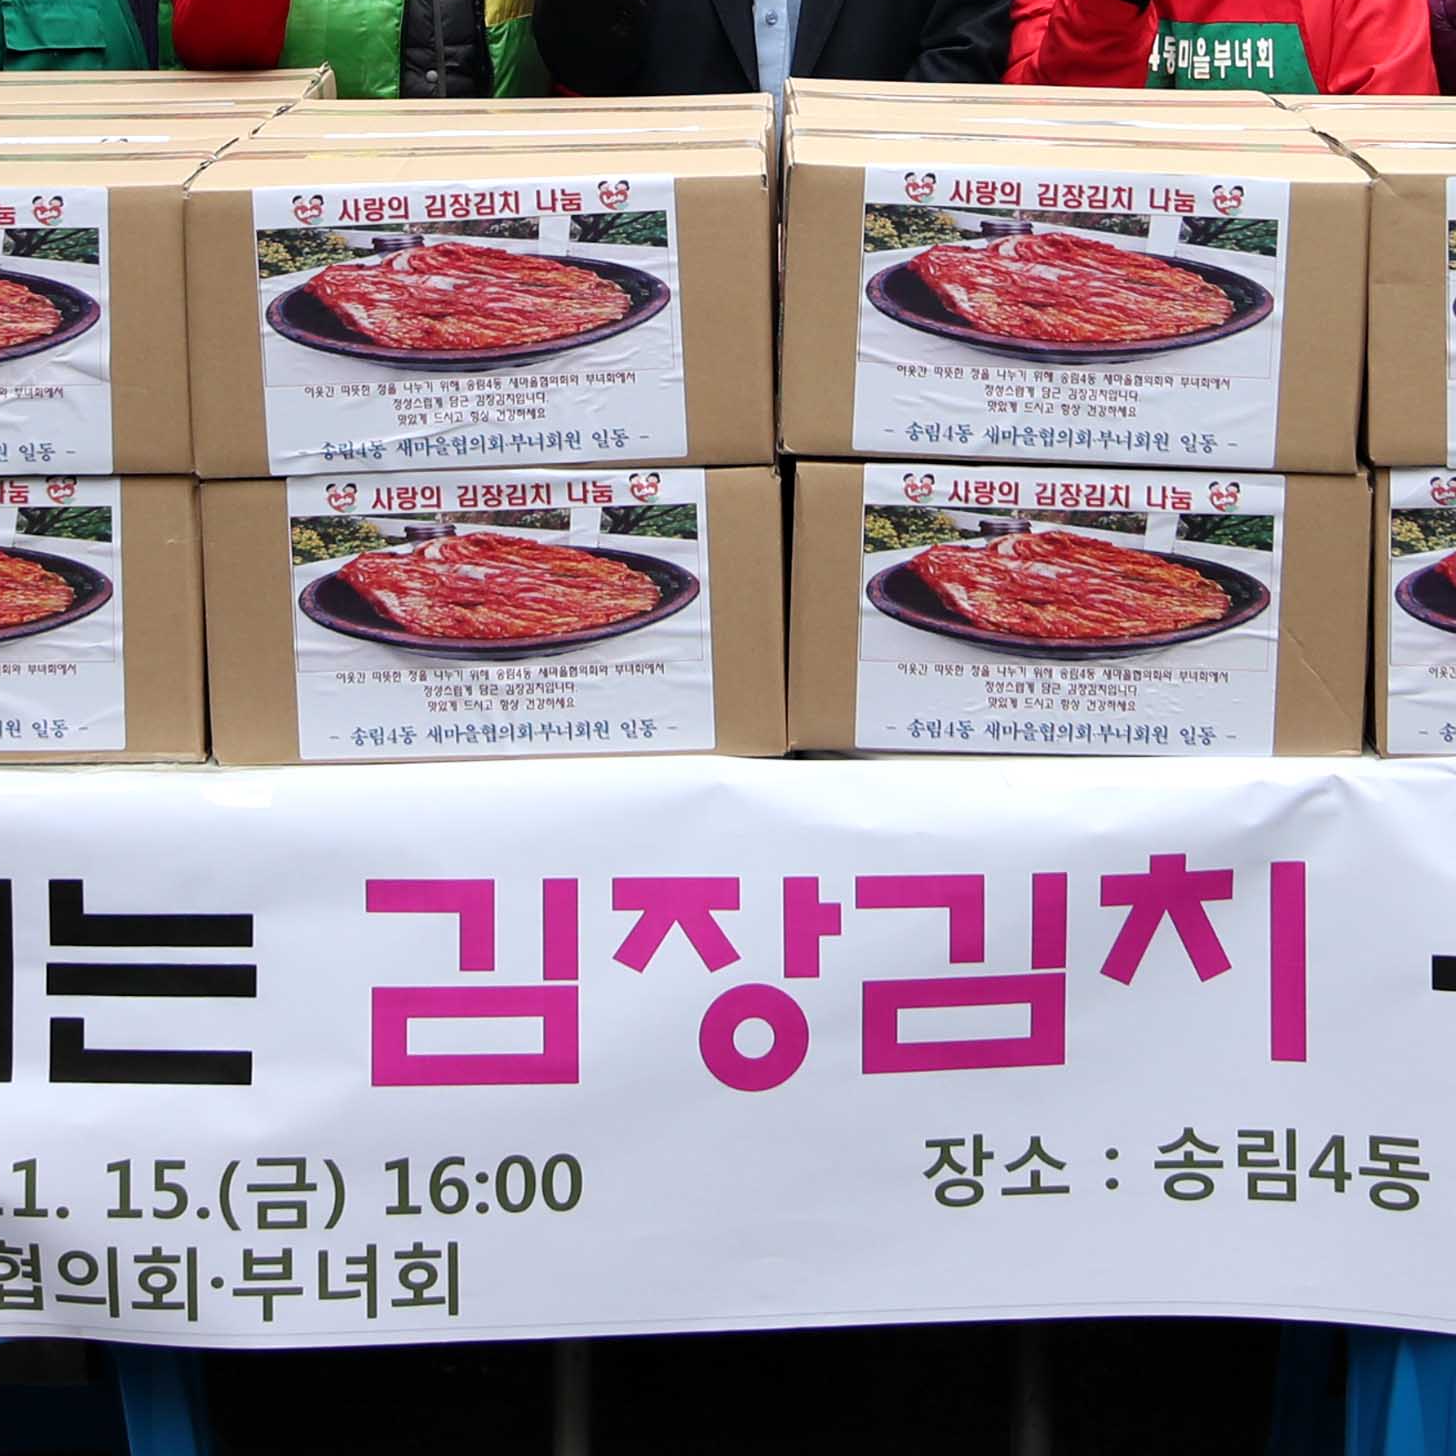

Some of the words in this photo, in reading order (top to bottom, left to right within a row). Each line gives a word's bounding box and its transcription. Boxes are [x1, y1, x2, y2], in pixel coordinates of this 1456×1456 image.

[338, 195, 411, 223] 사랑의
[424, 190, 521, 219] 김장김치
[534, 190, 583, 213] 나눔
[948, 179, 1022, 206] 사랑의
[1037, 182, 1134, 209] 김장김치
[1147, 190, 1196, 214] 나눔
[18, 442, 56, 463] 일동
[321, 440, 388, 462] 송림4동
[591, 428, 630, 449] 일동
[905, 421, 974, 444] 송림4동
[1180, 432, 1218, 454] 일동
[371, 485, 443, 511] 사랑의
[457, 482, 553, 508] 김장김치
[566, 481, 614, 505] 나눔
[946, 479, 1019, 507] 사랑의
[1033, 482, 1131, 508] 김장김치
[1145, 488, 1192, 512] 나눔
[31, 719, 69, 739] 일동
[350, 725, 417, 747] 송림4동
[620, 718, 658, 739] 일동
[906, 718, 975, 740] 송림4동
[1179, 725, 1217, 746] 일동
[366, 853, 1307, 1092] 김장김치
[922, 1134, 1071, 1208] 장소
[1153, 1127, 1431, 1212] 송림4동
[106, 1156, 346, 1231] 15.(금)
[384, 1152, 583, 1216] 16:00
